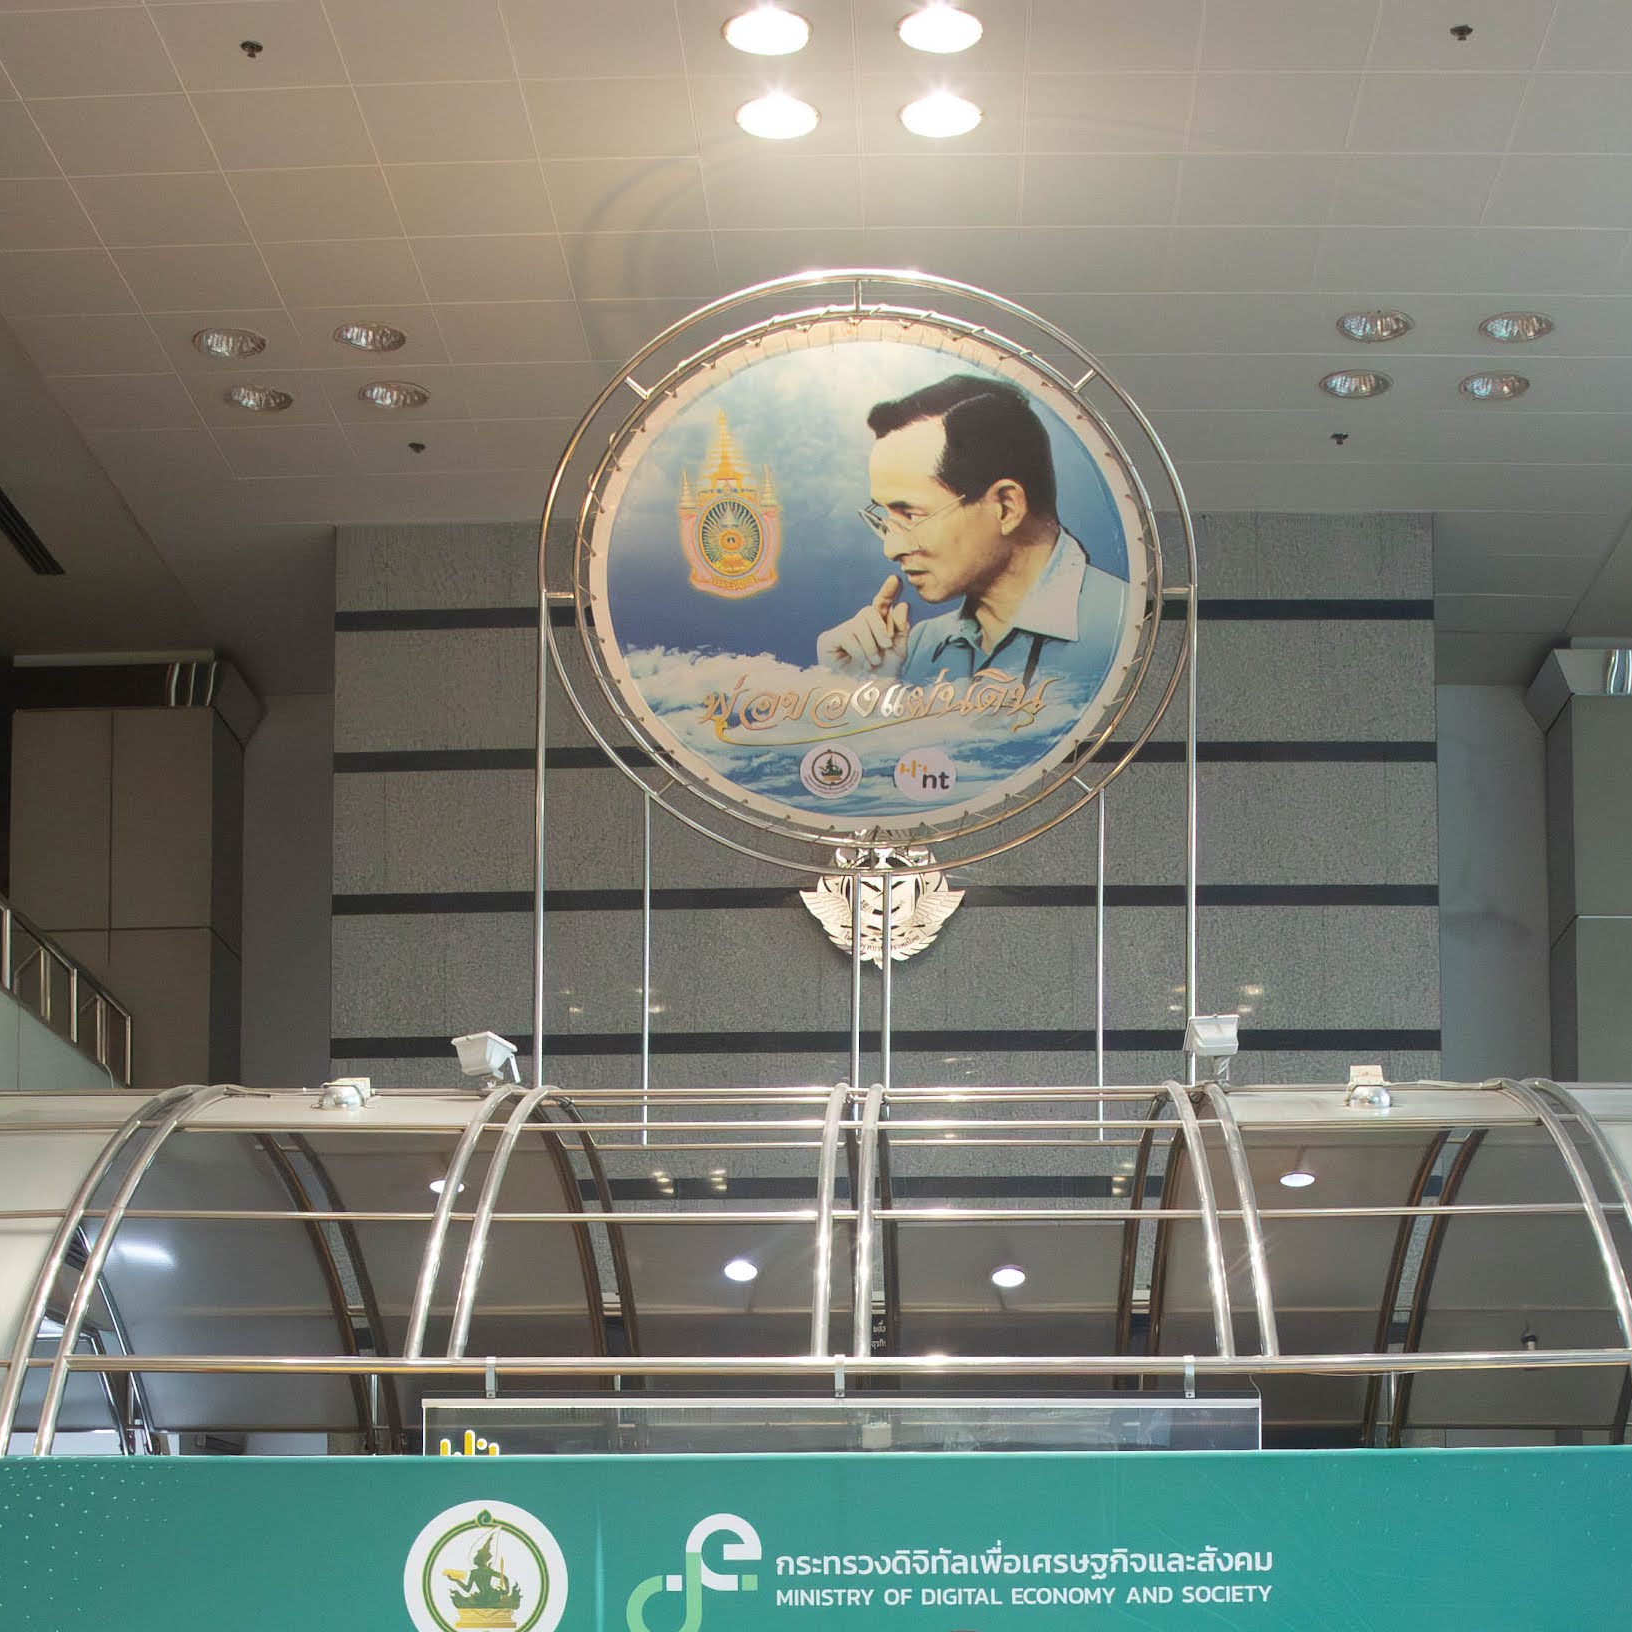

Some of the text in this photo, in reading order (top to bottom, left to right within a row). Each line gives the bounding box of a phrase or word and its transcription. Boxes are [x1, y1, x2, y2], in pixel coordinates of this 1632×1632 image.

[923, 771, 950, 790] nt
[776, 1539, 1273, 1579] กระทรวงดิจิทัลเพื่อเศรษฐกิจและสังคม
[776, 1585, 1272, 1606] MINISTRY OF DIGITAL ECONOMY AND SOCIETY
